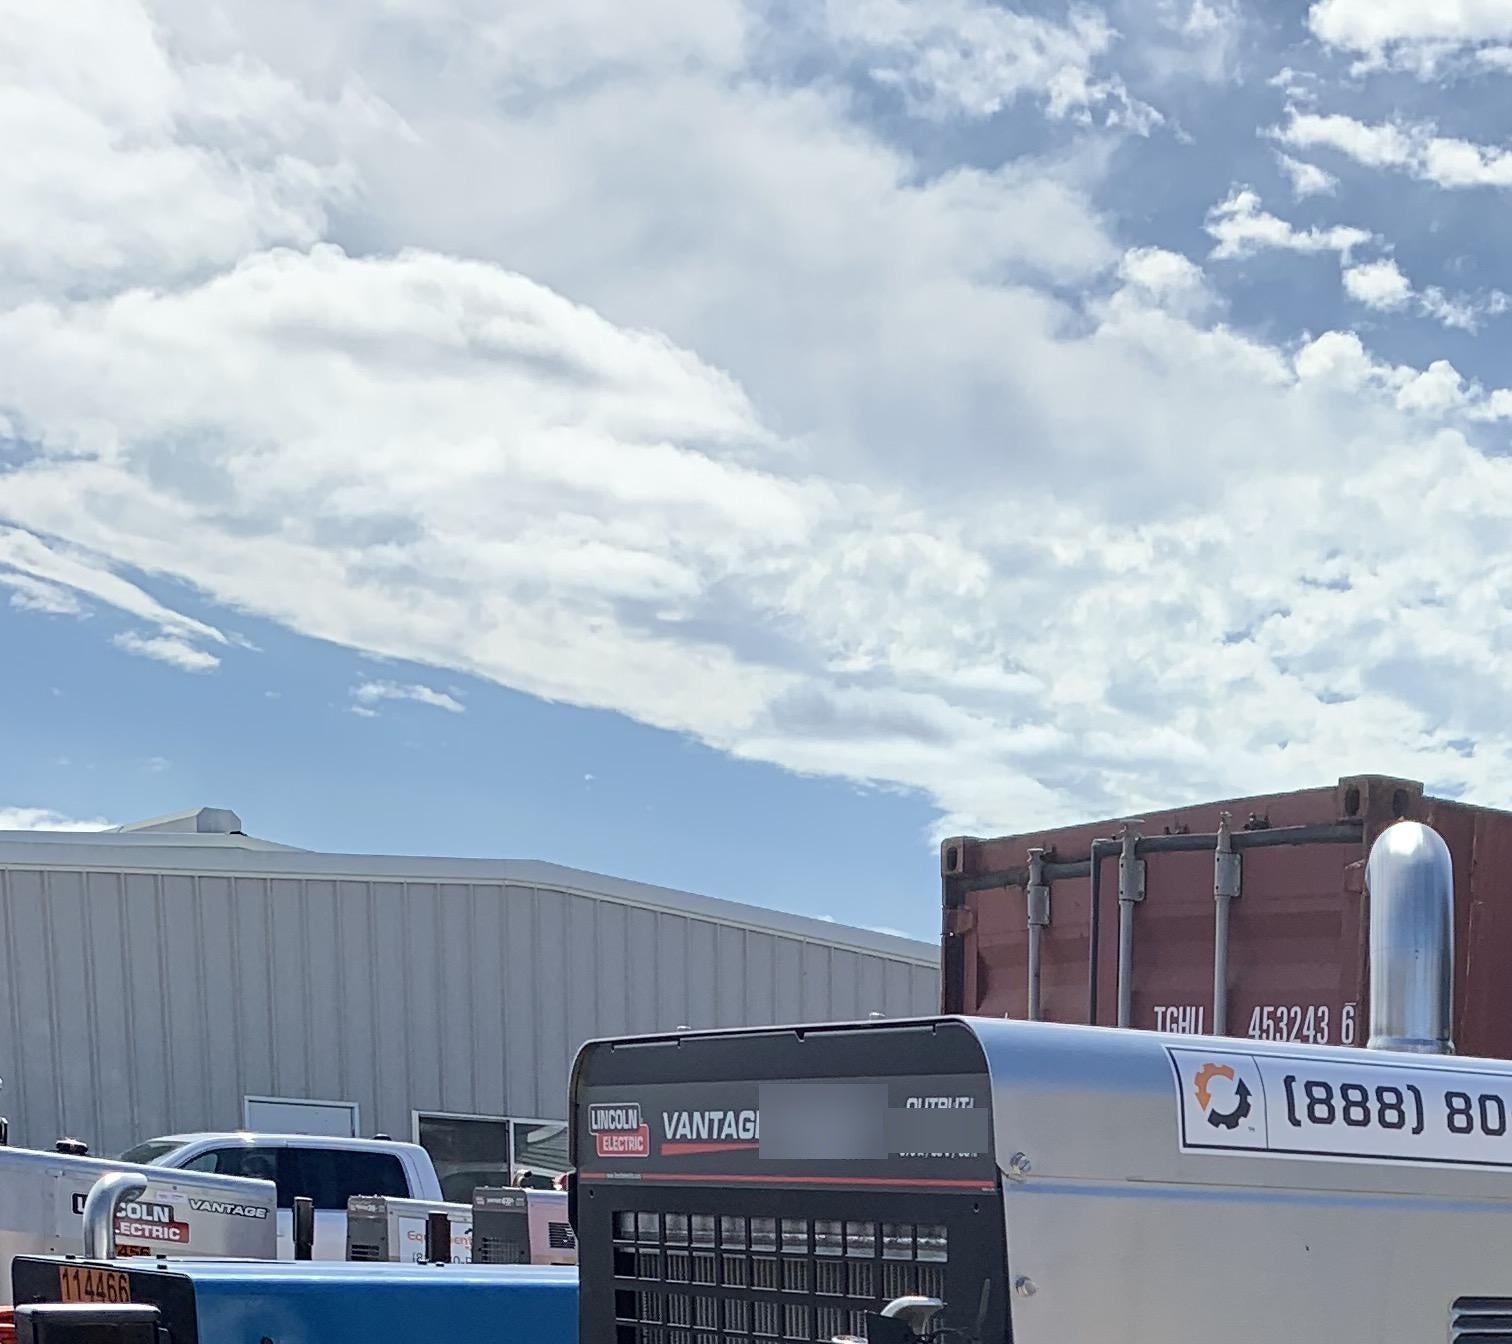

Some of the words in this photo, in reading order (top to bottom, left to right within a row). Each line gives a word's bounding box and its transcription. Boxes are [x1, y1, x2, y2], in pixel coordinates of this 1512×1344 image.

[1247, 1005, 1331, 1046] 453243
[1340, 1005, 1357, 1046] 6
[1283, 1074, 1424, 1135] (888)
[590, 1108, 639, 1131] LINCOLN
[602, 1133, 645, 1153] ELECTRIC
[189, 1198, 268, 1219] VANTAGE
[61, 1268, 130, 1304] 114466
